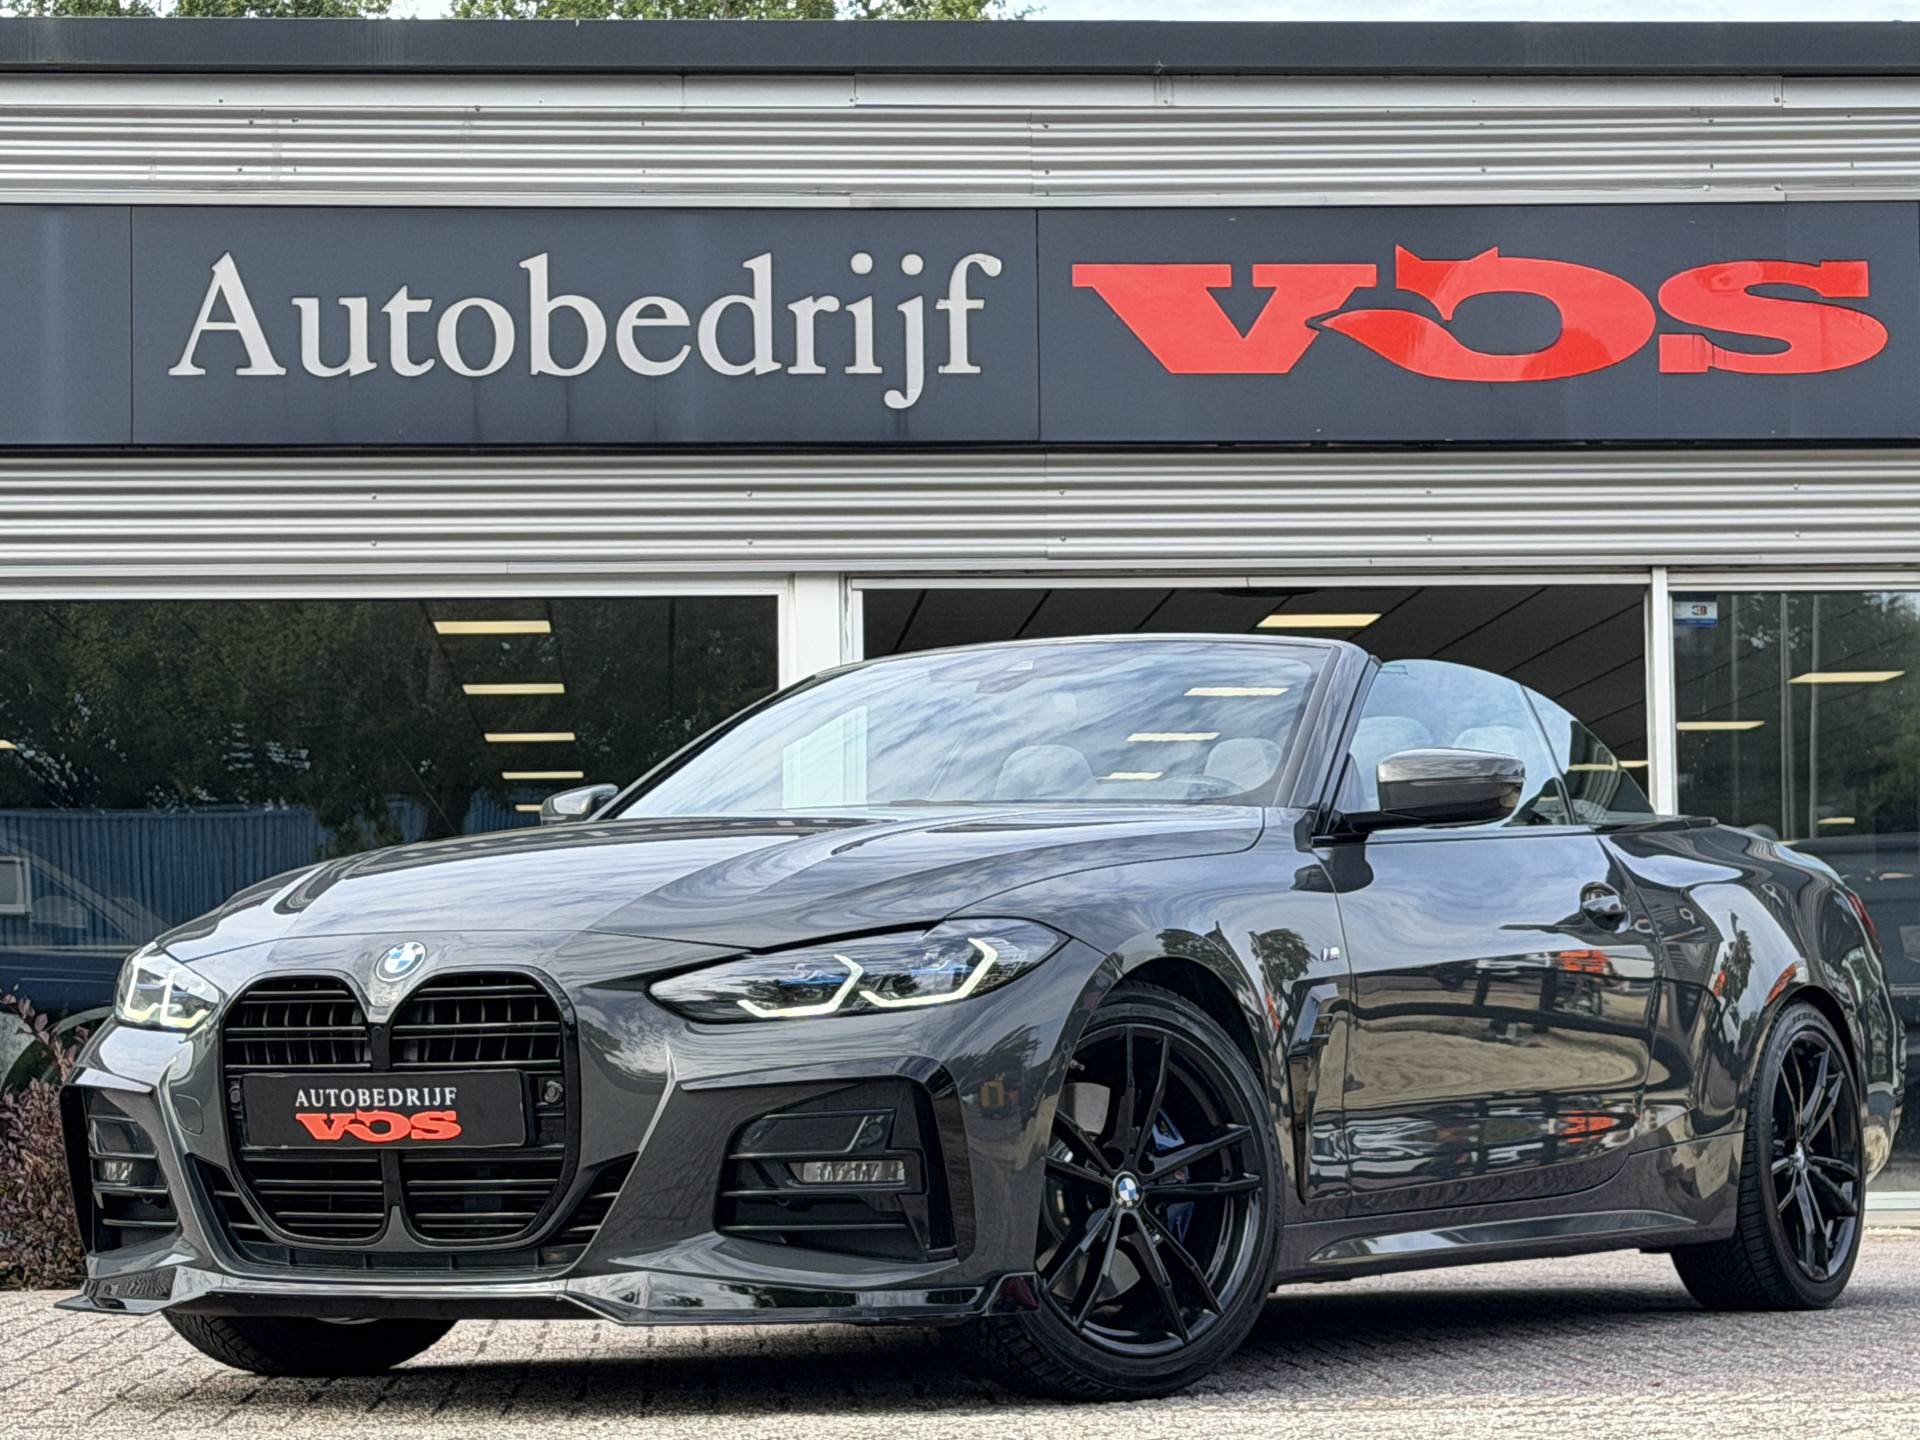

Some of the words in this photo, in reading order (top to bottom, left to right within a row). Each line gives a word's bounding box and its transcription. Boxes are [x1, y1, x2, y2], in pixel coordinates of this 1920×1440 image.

[169, 251, 1003, 410] Autobedrijf
[295, 1087, 457, 1107] AUTOBEDRIJF
[295, 1109, 462, 1142] VOS
